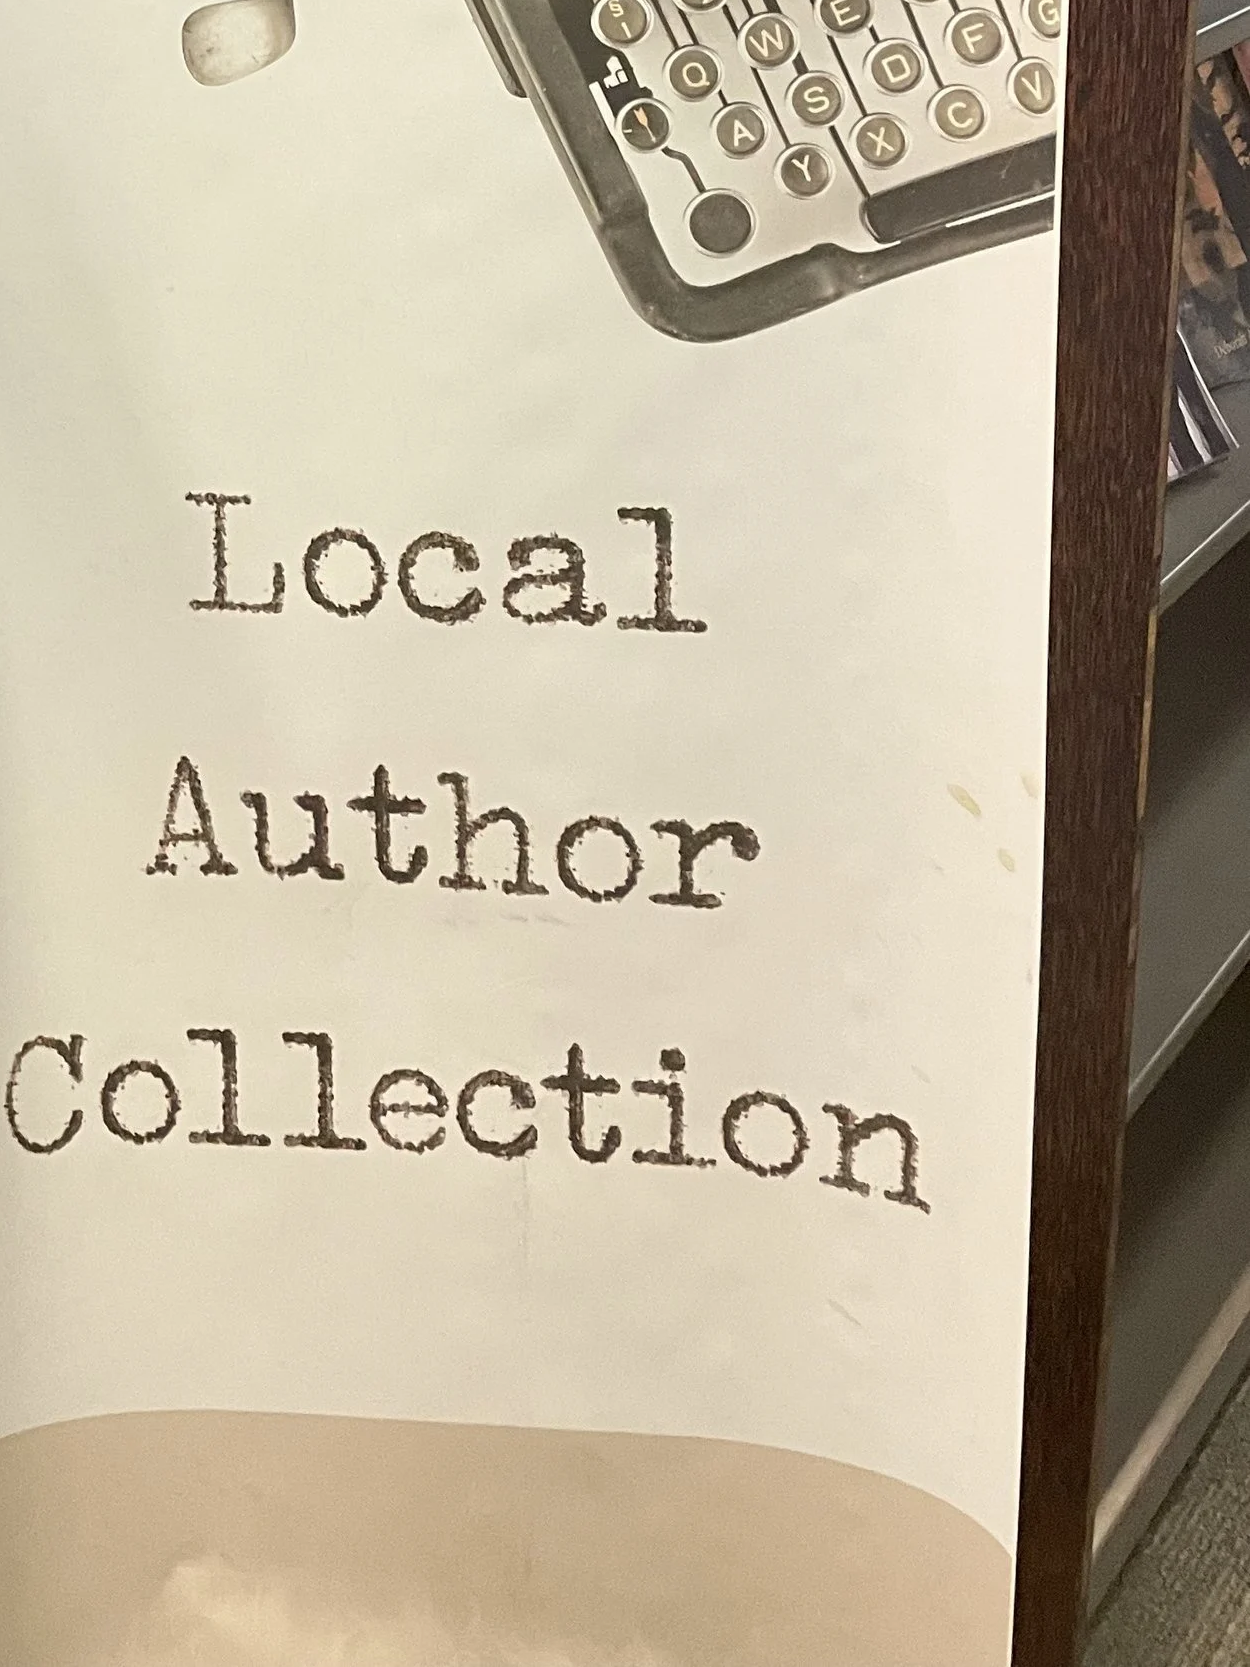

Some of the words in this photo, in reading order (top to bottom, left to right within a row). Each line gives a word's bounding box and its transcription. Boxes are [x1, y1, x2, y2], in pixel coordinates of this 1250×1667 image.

[682, 62, 710, 88] Q
[749, 23, 785, 58] W
[732, 118, 757, 147] A
[803, 86, 830, 114] S
[881, 54, 910, 83] D
[961, 22, 984, 54] F
[791, 154, 812, 182] Y
[866, 126, 895, 157] X
[947, 101, 973, 129] C
[1021, 70, 1042, 101] V
[185, 490, 708, 634] Local
[147, 754, 761, 909] Author
[5, 1026, 931, 1214] Collection
